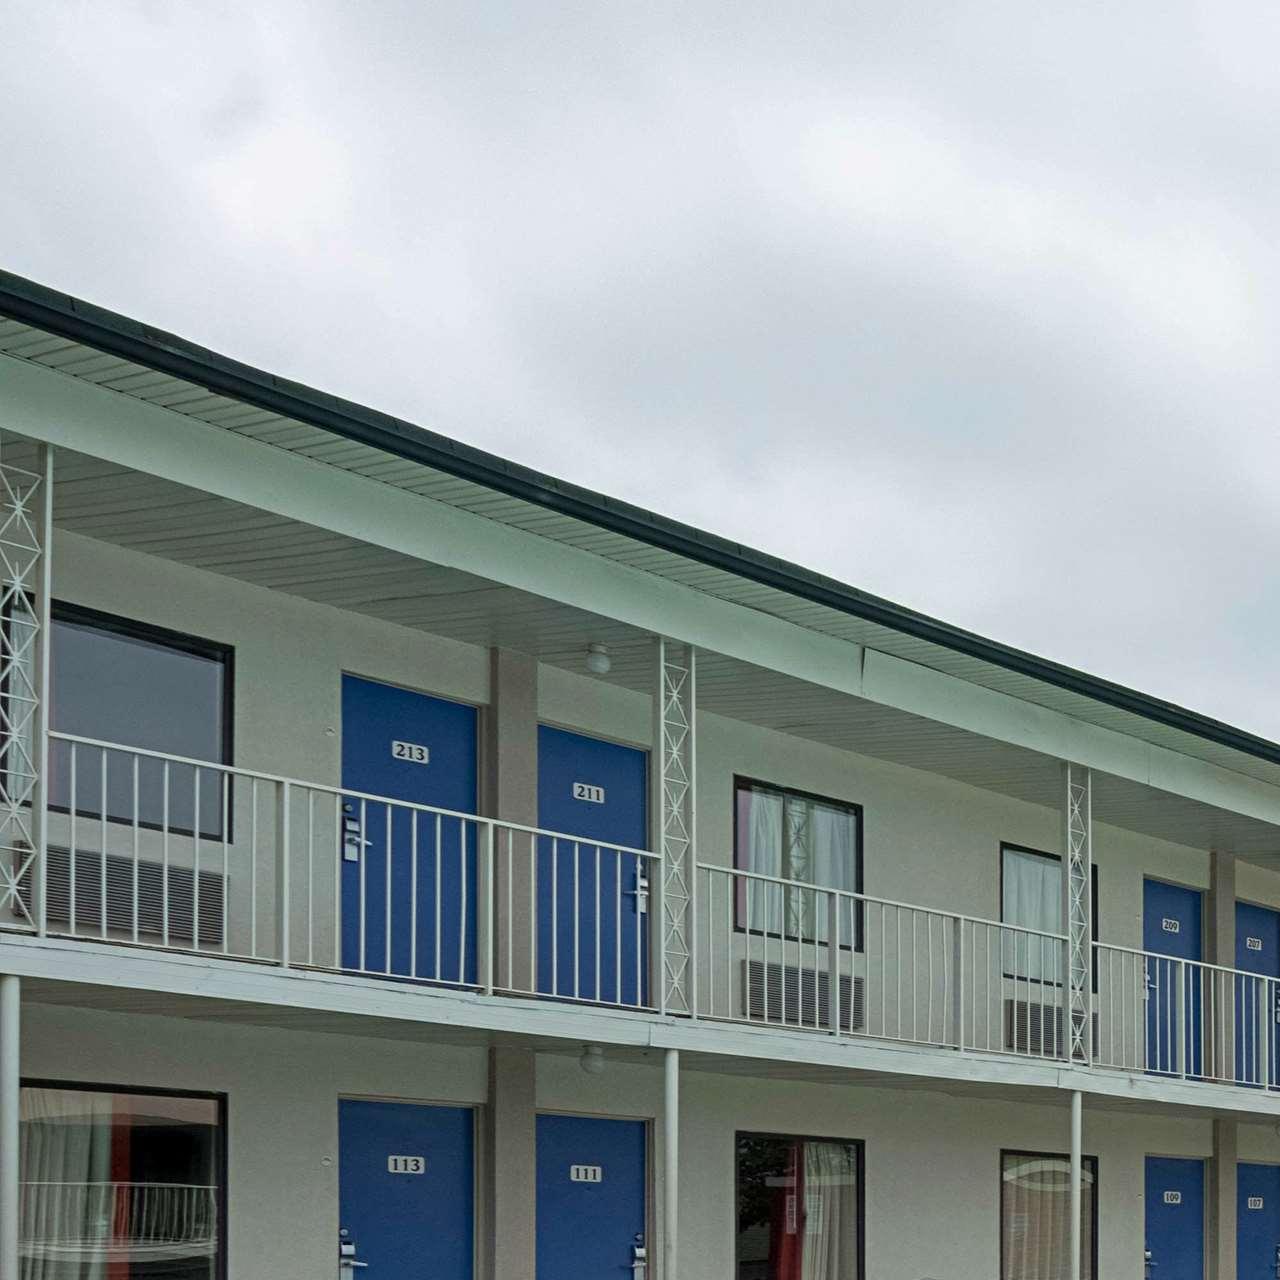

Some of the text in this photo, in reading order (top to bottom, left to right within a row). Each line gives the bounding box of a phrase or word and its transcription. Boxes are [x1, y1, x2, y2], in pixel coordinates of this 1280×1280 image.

[396, 744, 425, 761] 213
[577, 786, 601, 801] 211
[1164, 920, 1178, 931] 209
[391, 1158, 421, 1172] 113
[575, 1168, 599, 1180] 111
[1165, 1193, 1179, 1202] 109
